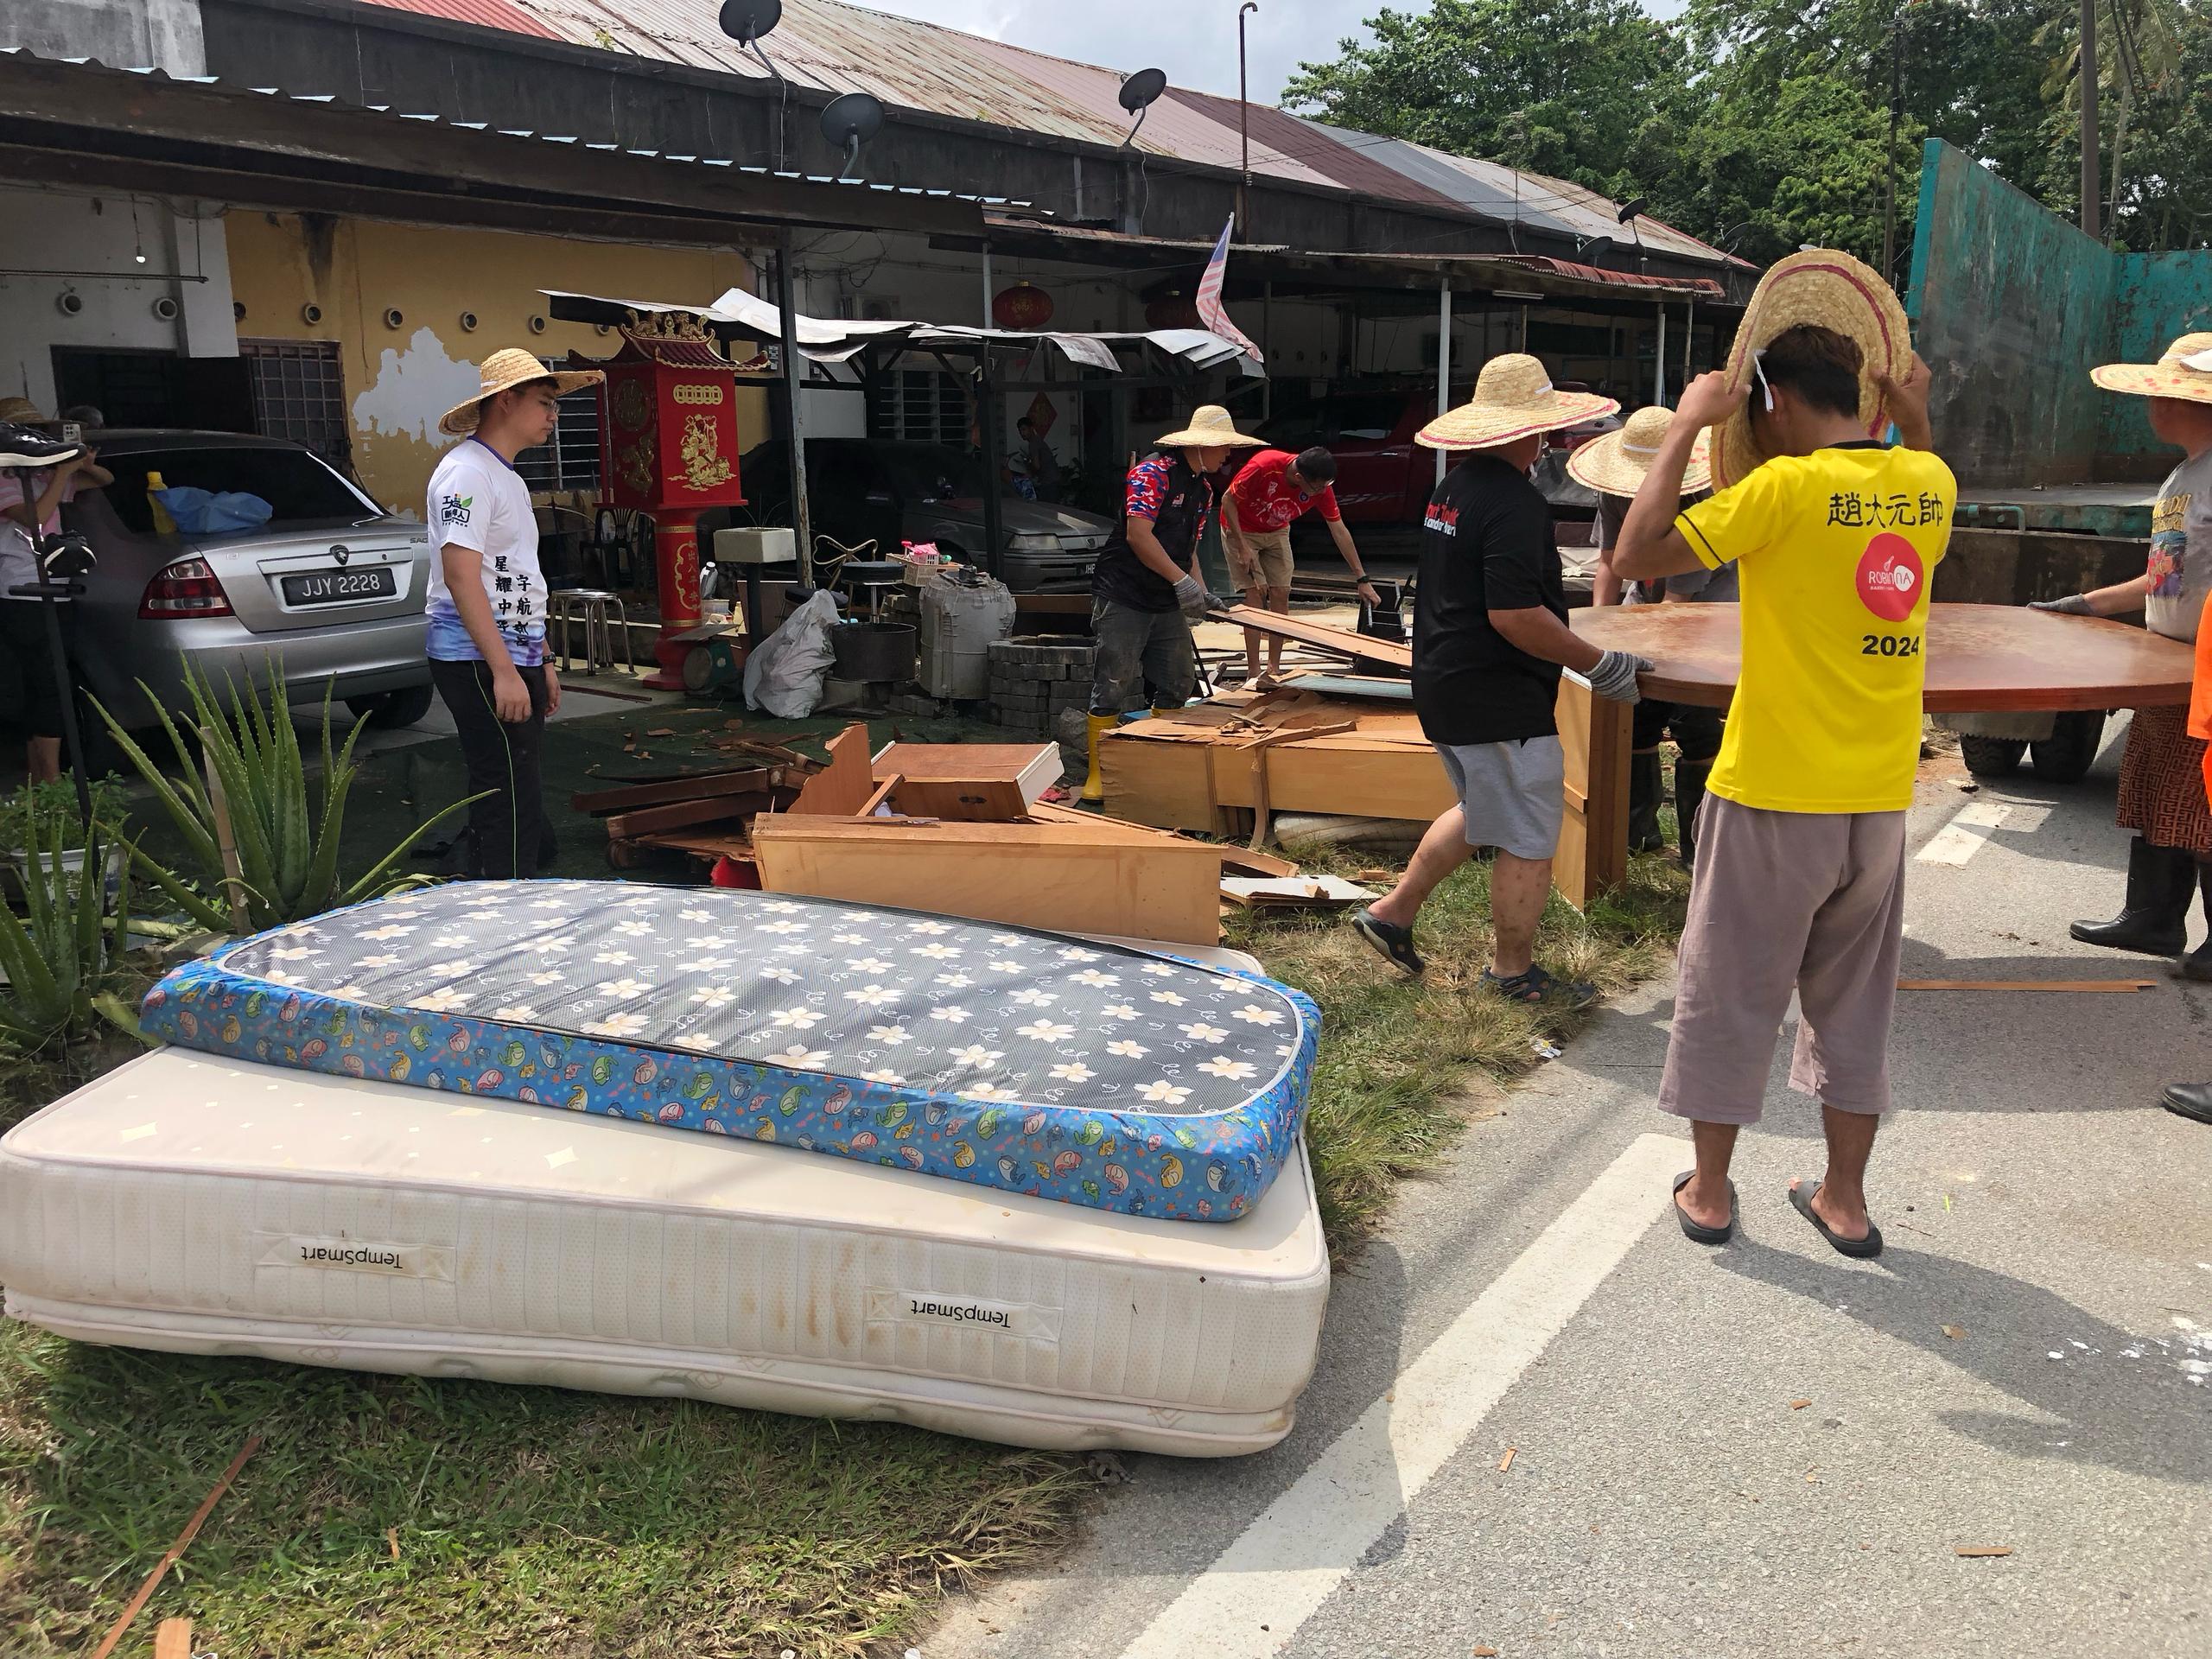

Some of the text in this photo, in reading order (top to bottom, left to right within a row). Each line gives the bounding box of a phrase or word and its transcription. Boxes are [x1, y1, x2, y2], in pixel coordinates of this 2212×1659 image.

[1827, 492, 1943, 528] 趙大元帥
[302, 574, 380, 597] JJY 2228
[1861, 634, 1920, 657] 2024
[301, 1246, 404, 1269] TempSmart
[911, 1300, 1011, 1329] TempSmart
